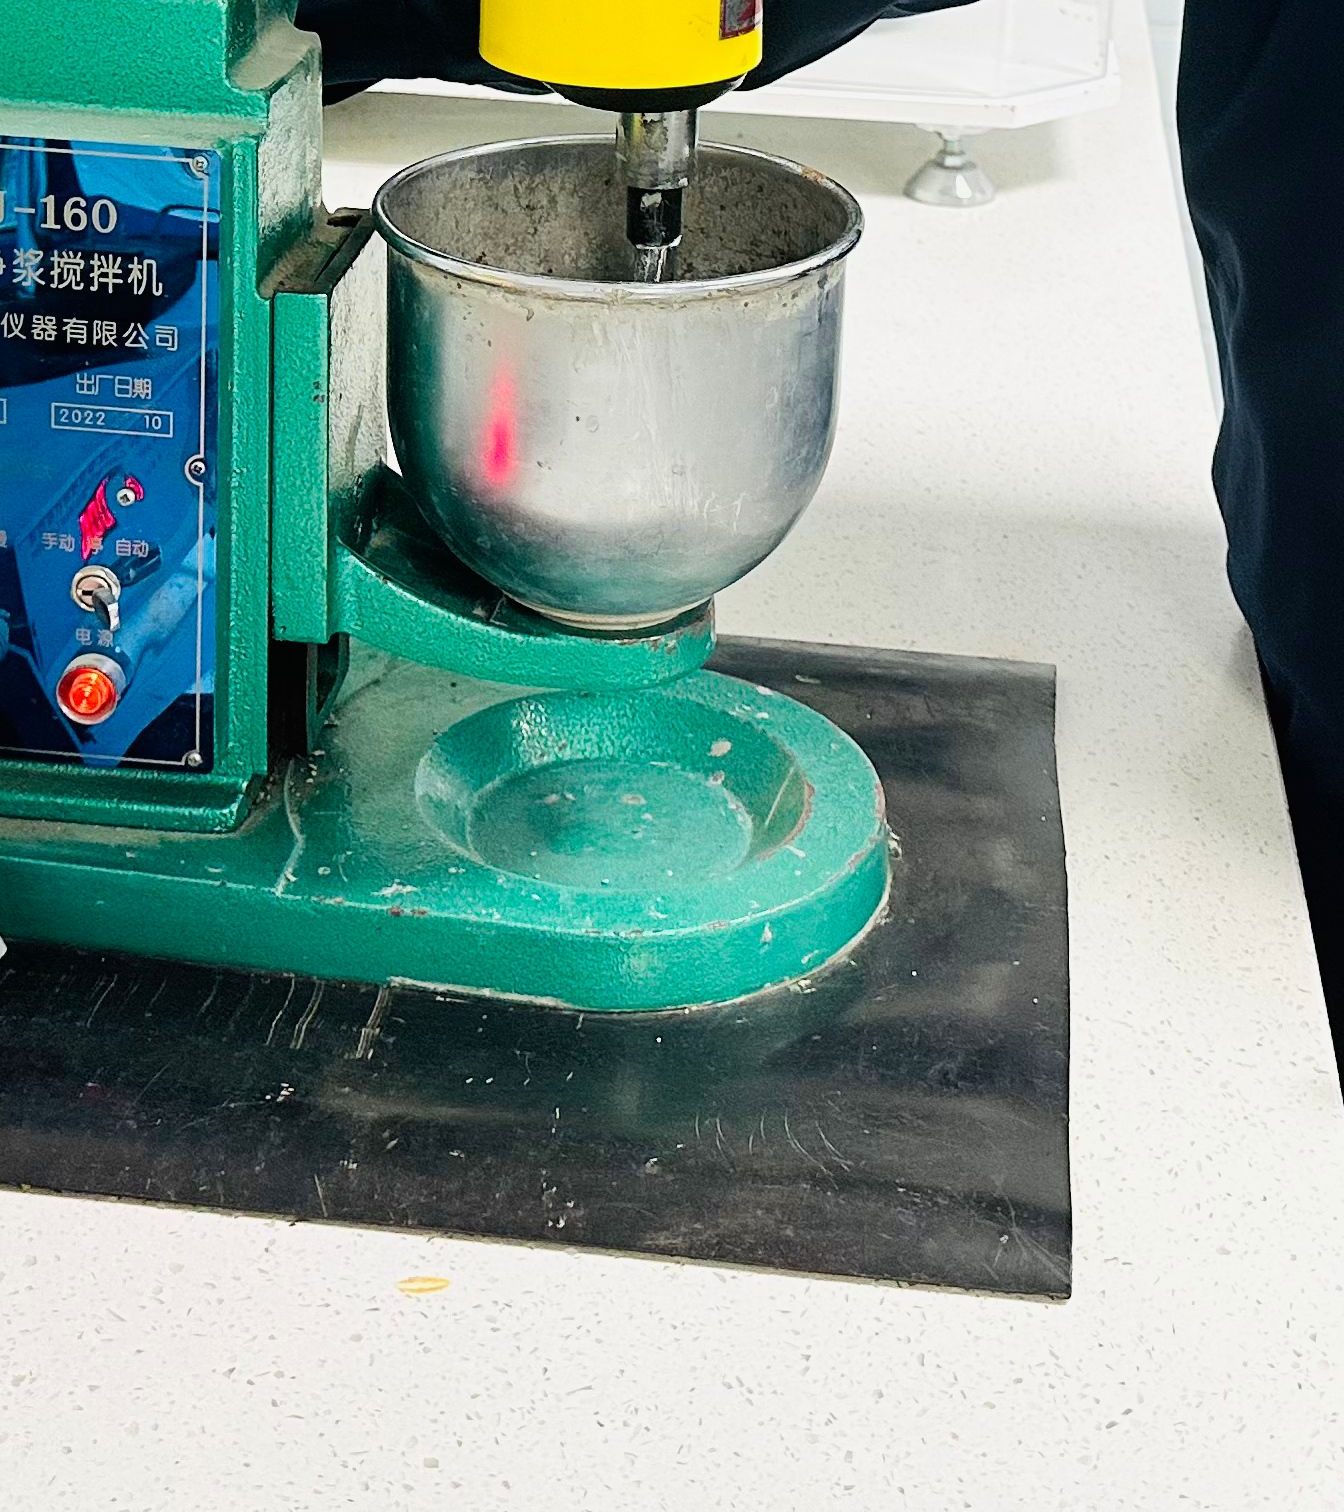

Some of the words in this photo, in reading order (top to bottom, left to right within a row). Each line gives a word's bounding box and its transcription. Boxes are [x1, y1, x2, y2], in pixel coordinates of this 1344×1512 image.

[75, 372, 153, 400] 出厂日期
[59, 408, 107, 426] 2022
[143, 413, 163, 430] 10
[41, 532, 76, 553] 手动
[115, 538, 150, 559] 自动
[75, 627, 115, 648] 电源
